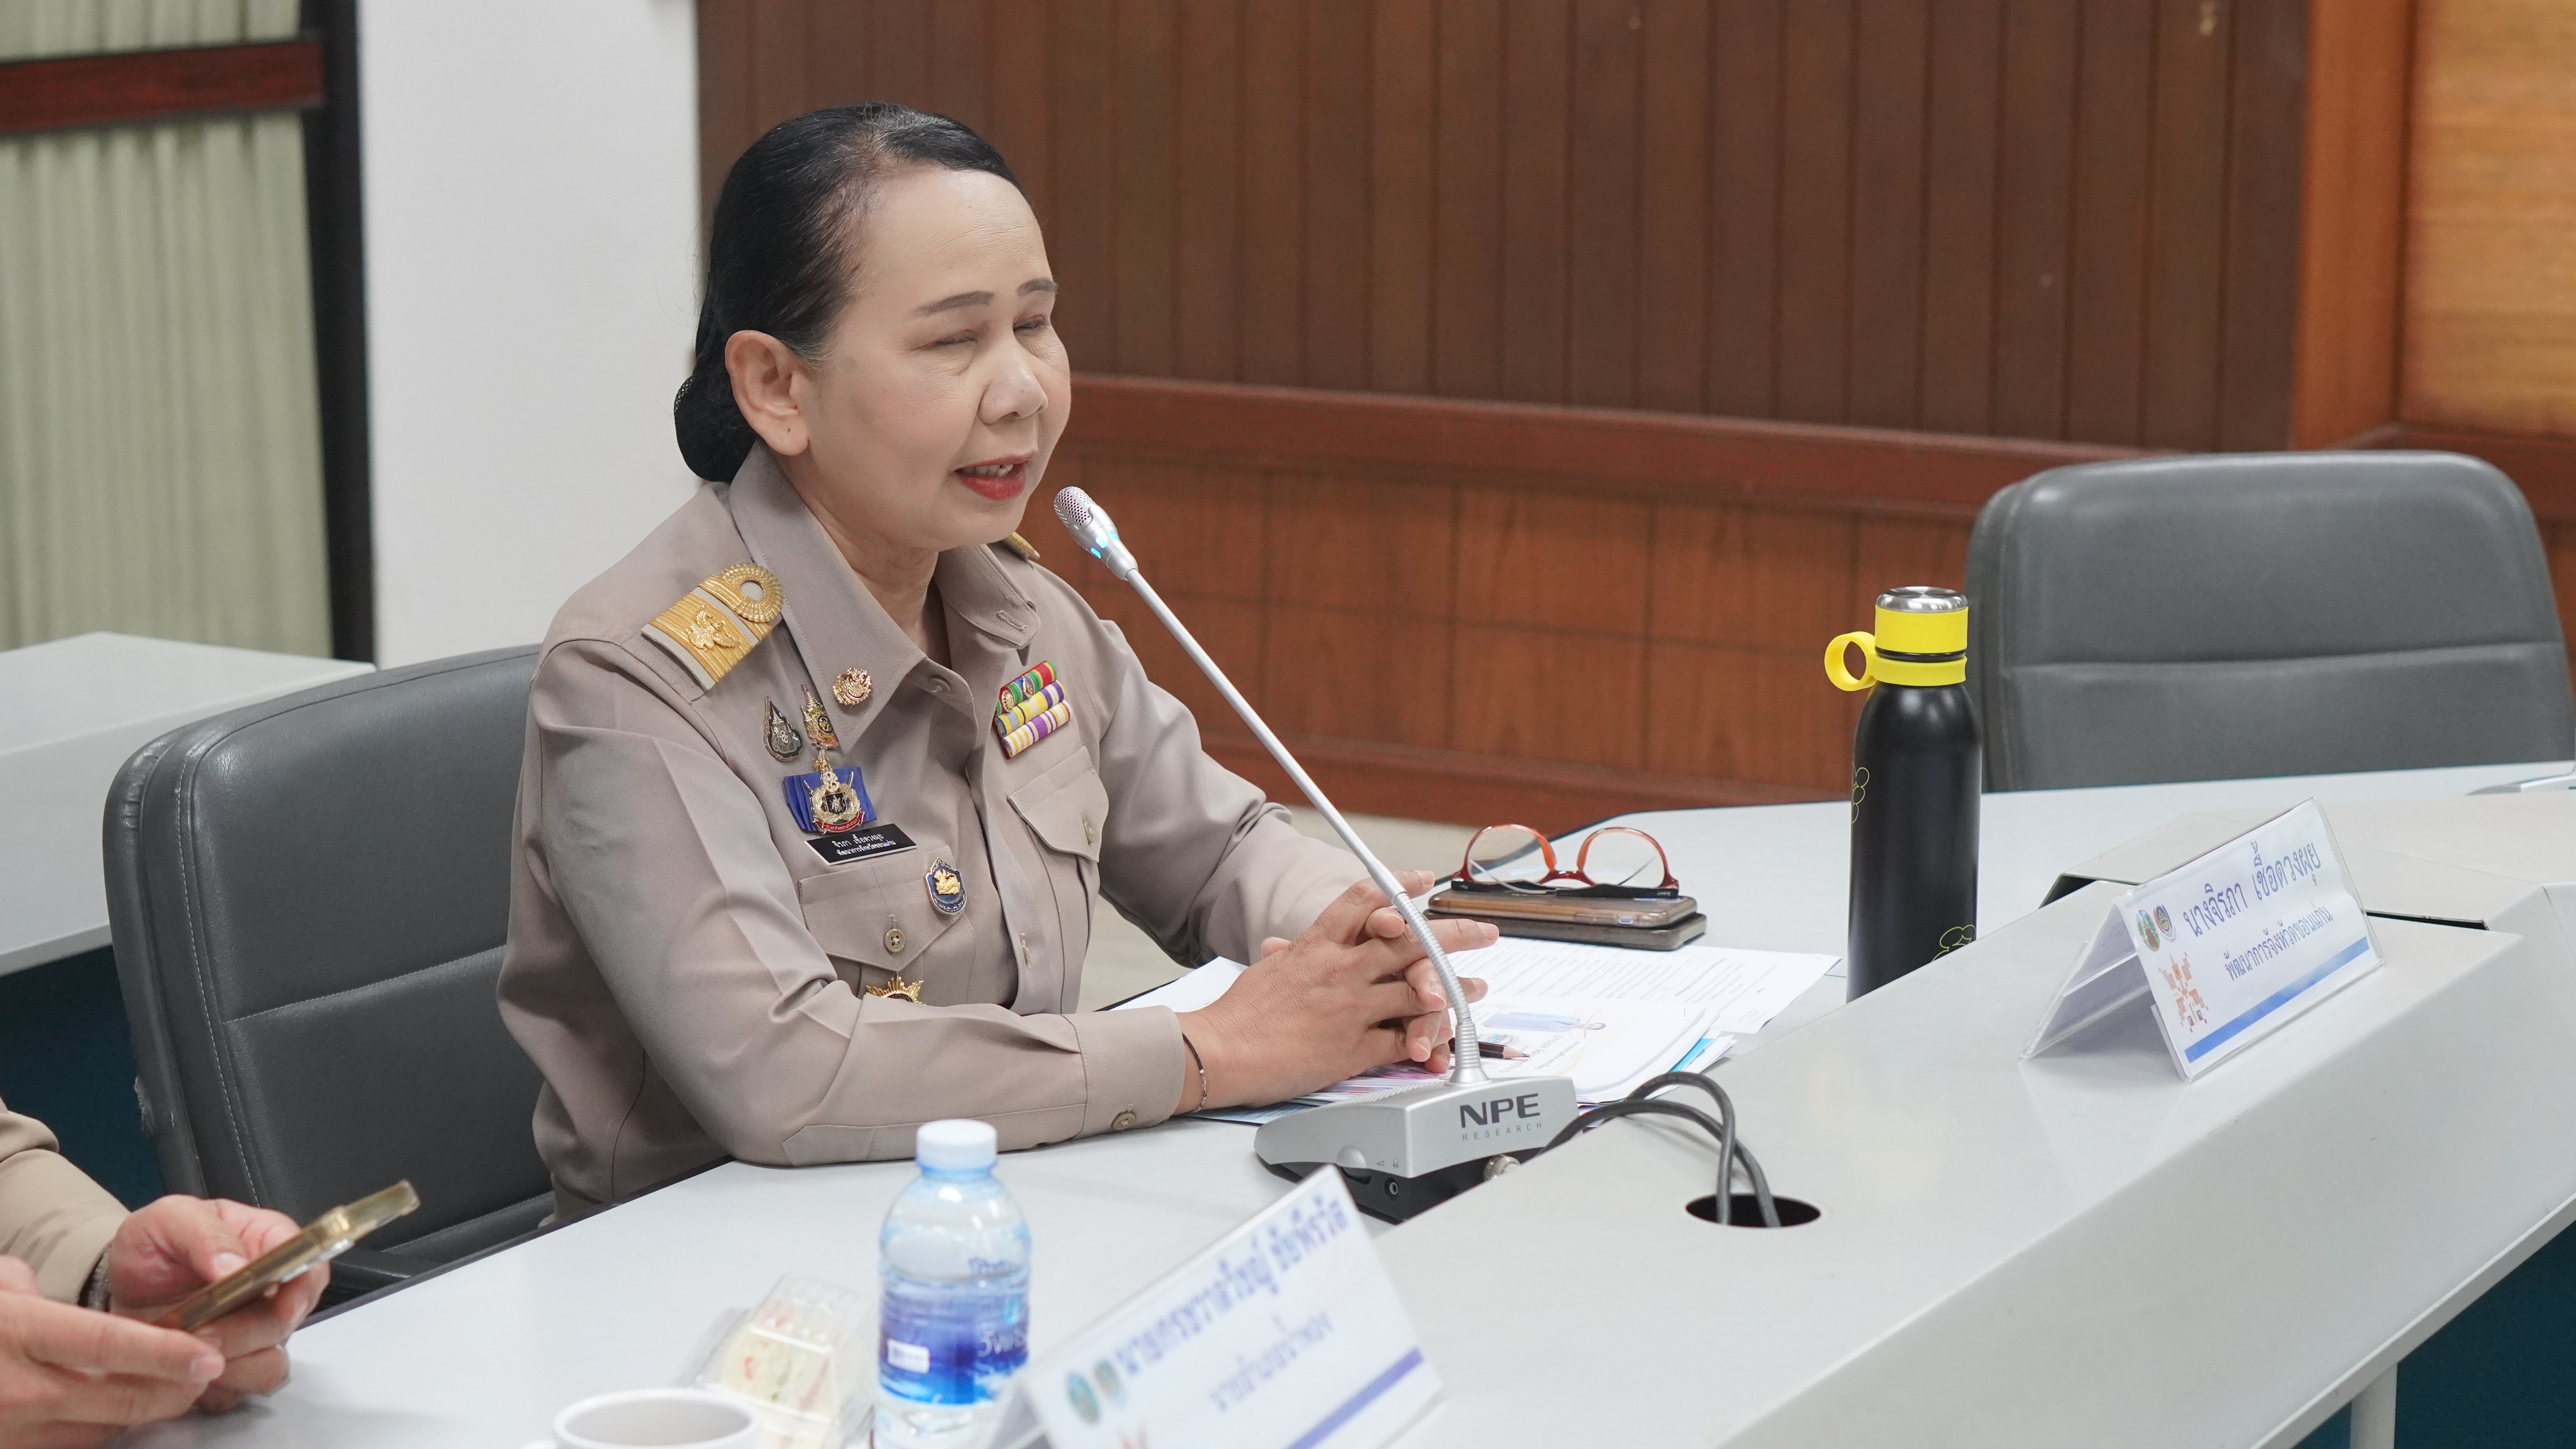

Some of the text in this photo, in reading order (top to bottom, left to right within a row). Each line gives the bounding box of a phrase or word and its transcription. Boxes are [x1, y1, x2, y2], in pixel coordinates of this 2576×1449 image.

[836, 840, 896, 856] พัฒนาการจังหวัดขอนแก่น
[853, 834, 884, 844] เชื้อดวงผุย
[2183, 840, 2321, 937] นางจิรภา เชื้อดวงผุย
[2224, 902, 2334, 982] พัฒนาการจังหวัดขอนแก่น
[1460, 1093, 1540, 1128] NPE
[1462, 1121, 1542, 1141] RESEARCH
